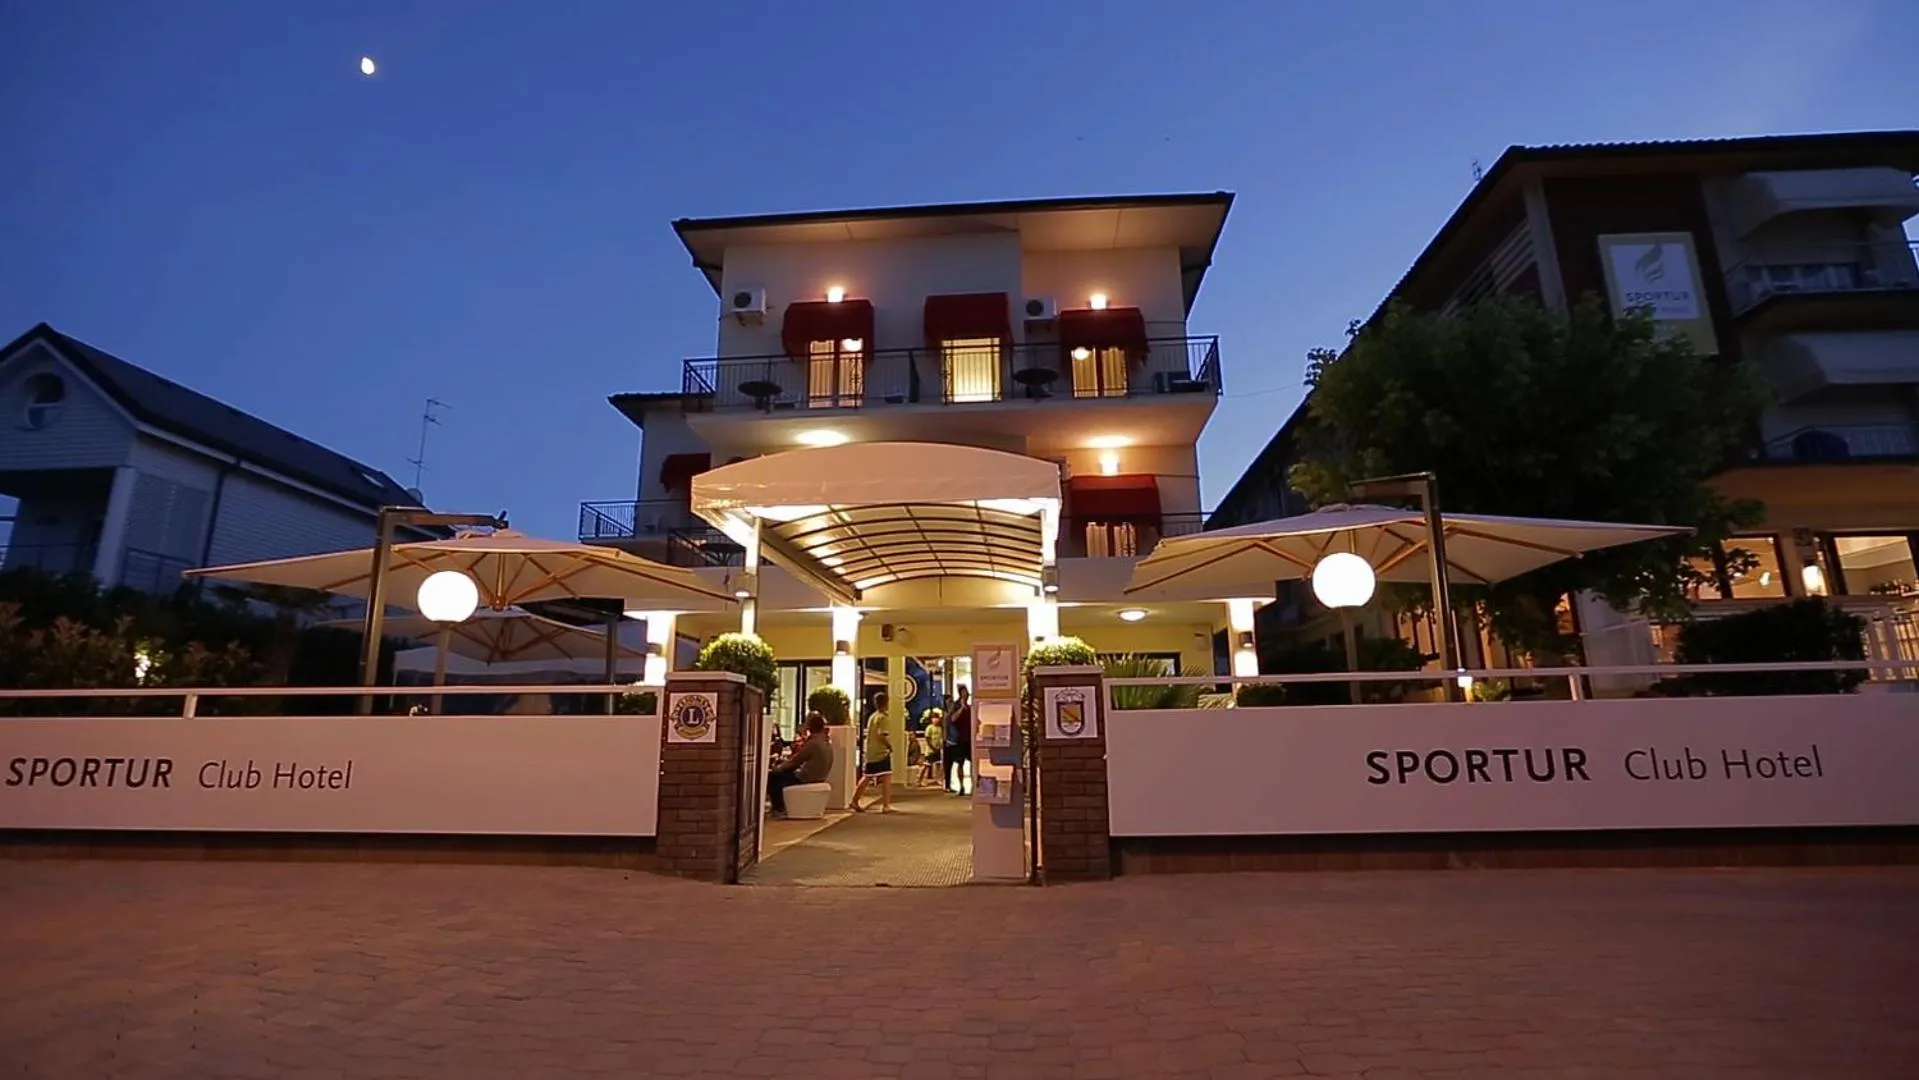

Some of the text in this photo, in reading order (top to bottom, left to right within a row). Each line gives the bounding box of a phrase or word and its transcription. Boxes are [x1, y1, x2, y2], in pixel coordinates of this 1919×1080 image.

[5, 757, 352, 789] SPORTUR Club Hotel
[1366, 744, 1823, 784] SPORTUR Club Hotel
